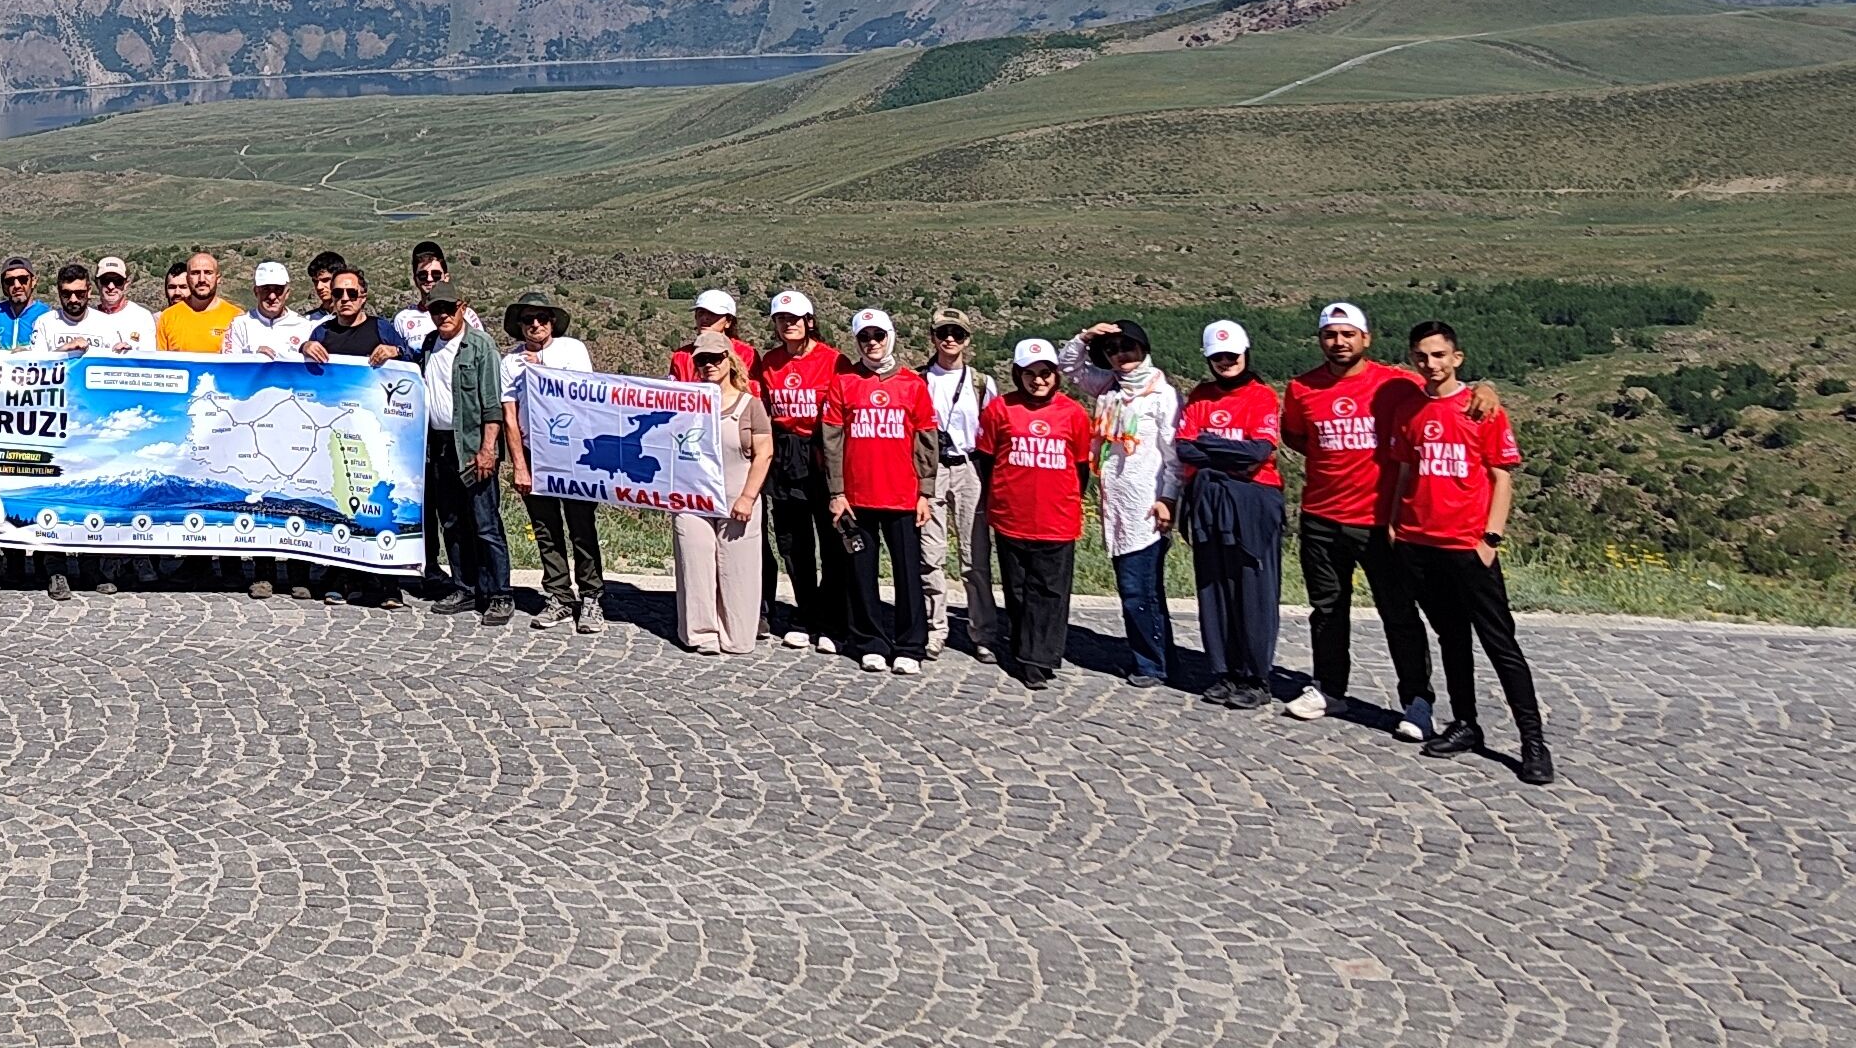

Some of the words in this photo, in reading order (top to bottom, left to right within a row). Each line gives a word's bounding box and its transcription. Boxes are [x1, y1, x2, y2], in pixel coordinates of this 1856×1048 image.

[58, 335, 100, 348] ADAS
[11, 362, 66, 387] GÖLÜ
[5, 388, 65, 408] HATTI
[537, 376, 564, 398] VAN
[568, 379, 607, 404] GÖLÜ
[611, 383, 712, 414] KİRLENMESİN
[789, 403, 819, 418] CLUB
[853, 409, 905, 424] TATVAN
[851, 423, 876, 438] RUN
[1313, 416, 1376, 435] TATVAN
[1010, 436, 1067, 454] TATVAN
[1344, 432, 1378, 450] CLUB
[1008, 451, 1035, 467] RUN
[1036, 453, 1067, 470] CLUB
[1430, 458, 1469, 479] CLUB
[547, 475, 608, 500] MAVİ
[616, 487, 715, 512] KALSIN
[362, 503, 381, 515] VAN
[87, 534, 103, 542] MUŞ
[132, 533, 154, 541] BİTLİS
[182, 534, 207, 542] TATVAN
[379, 553, 394, 561] VAN
